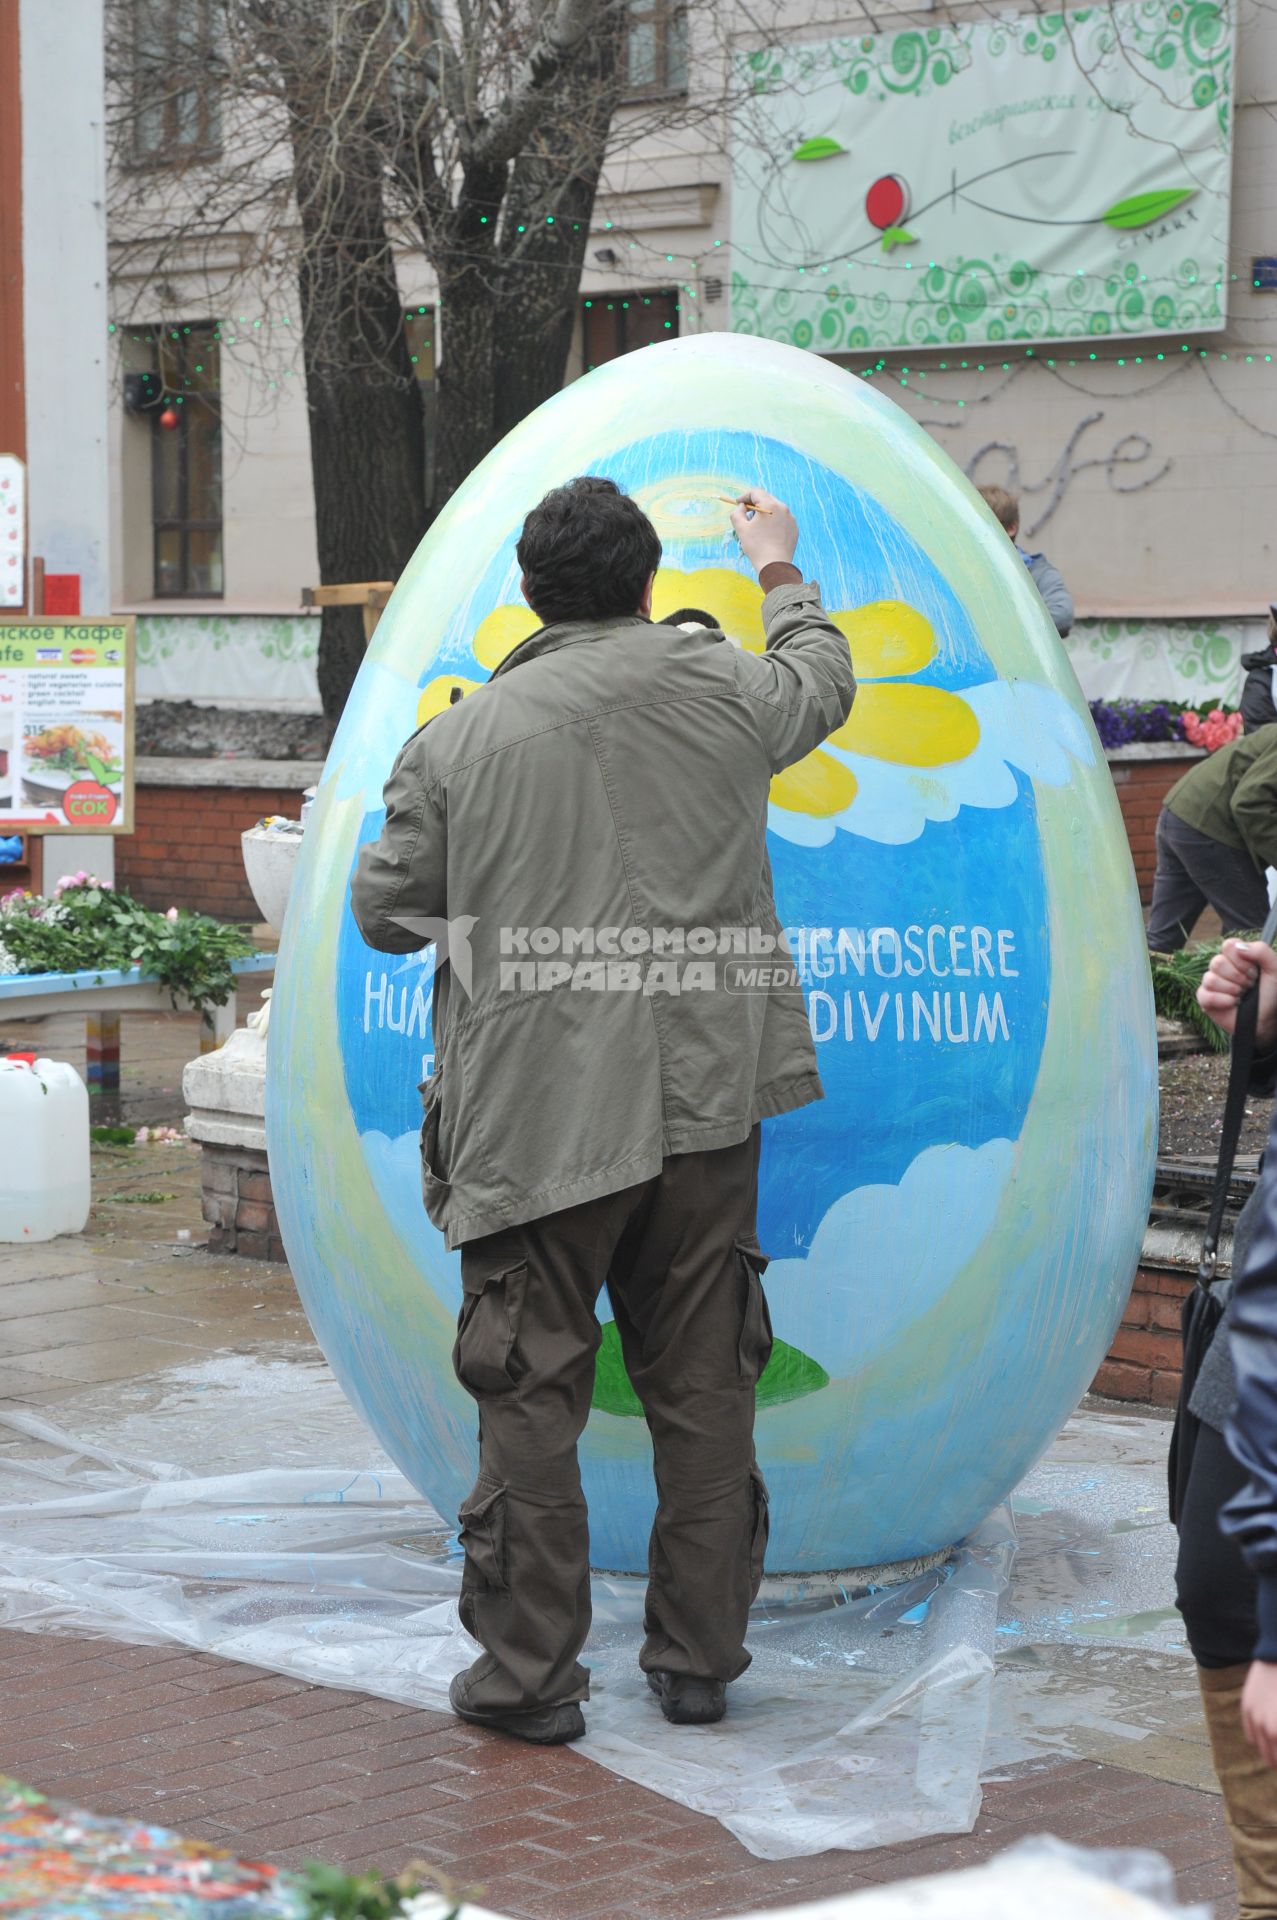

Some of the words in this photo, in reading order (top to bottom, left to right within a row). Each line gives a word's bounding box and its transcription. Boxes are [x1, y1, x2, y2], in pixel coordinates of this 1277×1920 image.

[64, 625, 123, 645] Кафе
[28, 680, 46, 689] light
[49, 681, 91, 689] vegetarian
[28, 690, 50, 698] green
[28, 699, 55, 707] english
[69, 800, 109, 816] СОК
[799, 924, 1020, 978] IGNOSCERE
[809, 990, 1010, 1043] DIVINUM
